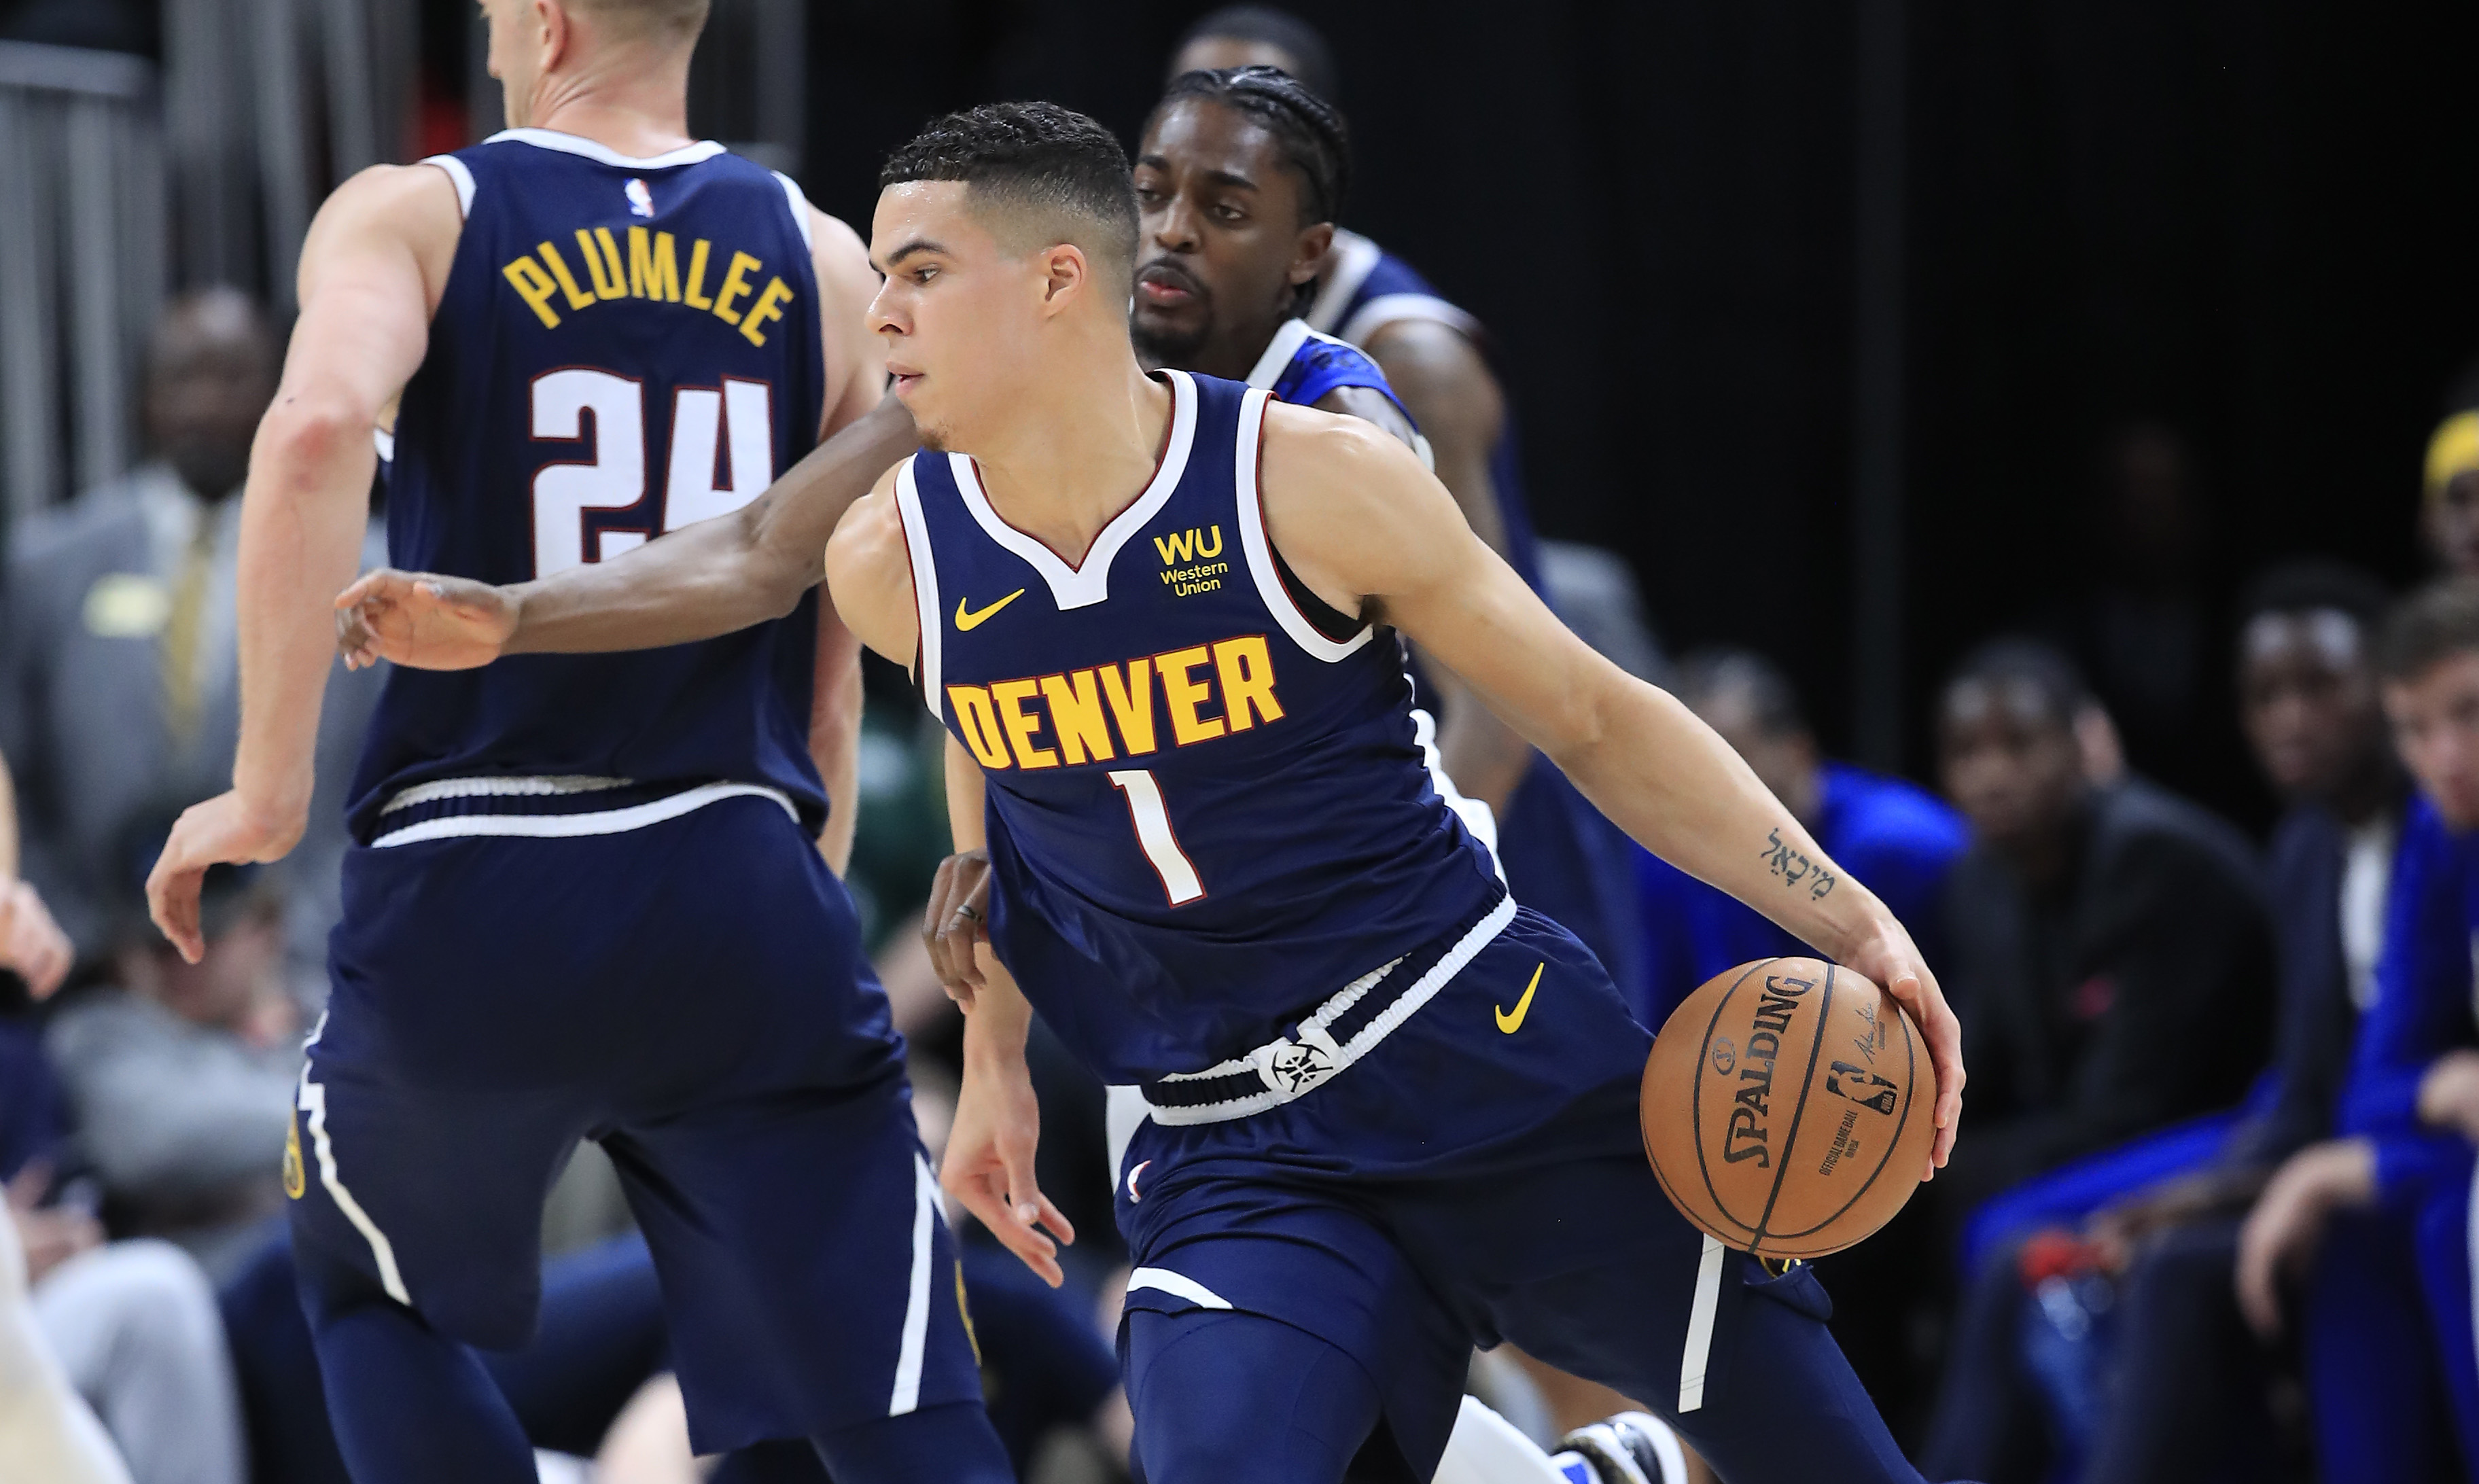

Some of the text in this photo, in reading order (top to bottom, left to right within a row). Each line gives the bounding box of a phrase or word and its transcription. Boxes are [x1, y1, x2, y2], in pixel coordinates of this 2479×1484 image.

[503, 226, 795, 347] PLUMLEE
[530, 366, 773, 579] 24
[1153, 525, 1223, 566] WU
[1160, 562, 1228, 585] Western
[1174, 579, 1221, 597] Union
[946, 634, 1286, 770] DENVER
[1106, 769, 1208, 909] 1
[1724, 976, 1814, 1168] SPALDING
[1819, 1147, 1842, 1176] OFFICIAL
[1842, 1109, 1858, 1128] BALL
